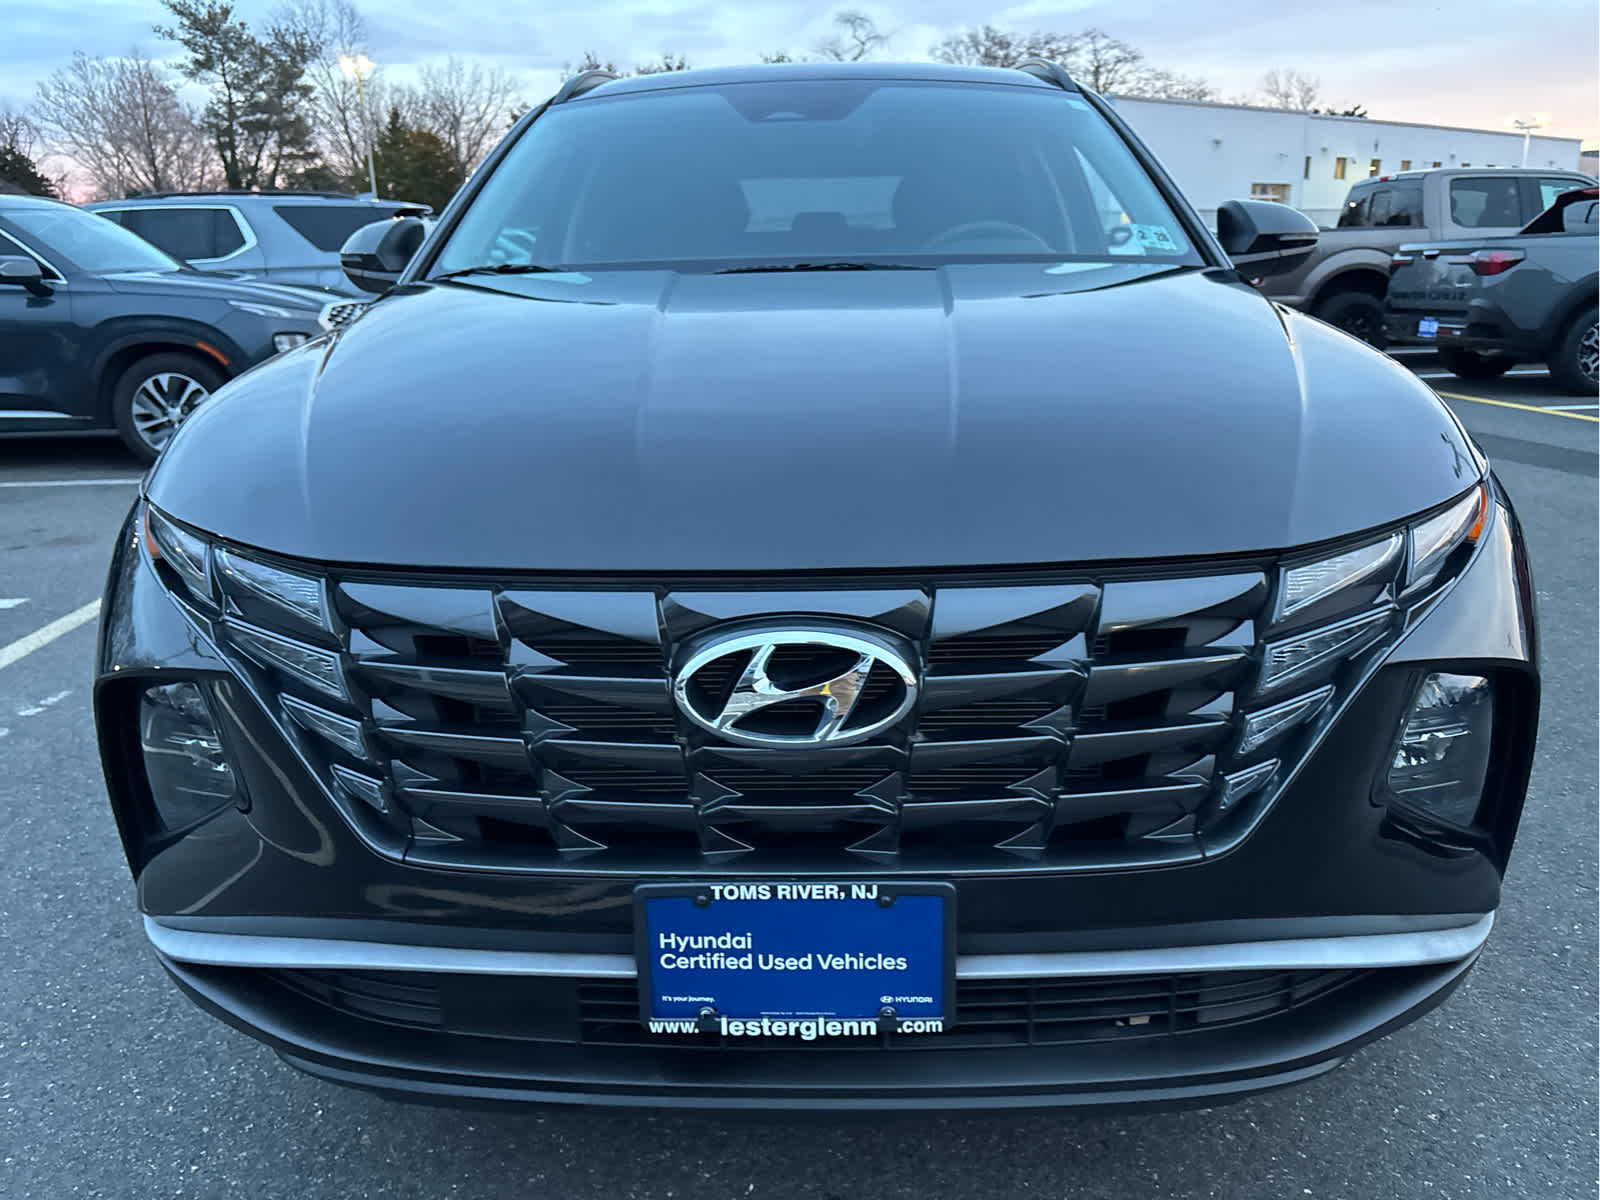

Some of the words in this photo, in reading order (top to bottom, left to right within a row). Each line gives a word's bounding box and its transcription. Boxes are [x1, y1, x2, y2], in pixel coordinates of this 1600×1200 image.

[710, 885, 771, 900] TOMS
[777, 885, 846, 900] RIVER,
[851, 884, 878, 900] NJ
[659, 932, 752, 953] Hyundai
[659, 953, 753, 970] Certified
[758, 954, 813, 970] Used
[816, 953, 908, 970] Vehicles
[649, 1021, 700, 1034] www.
[720, 1016, 877, 1041] lesterglenn
[897, 1020, 943, 1034] .com
